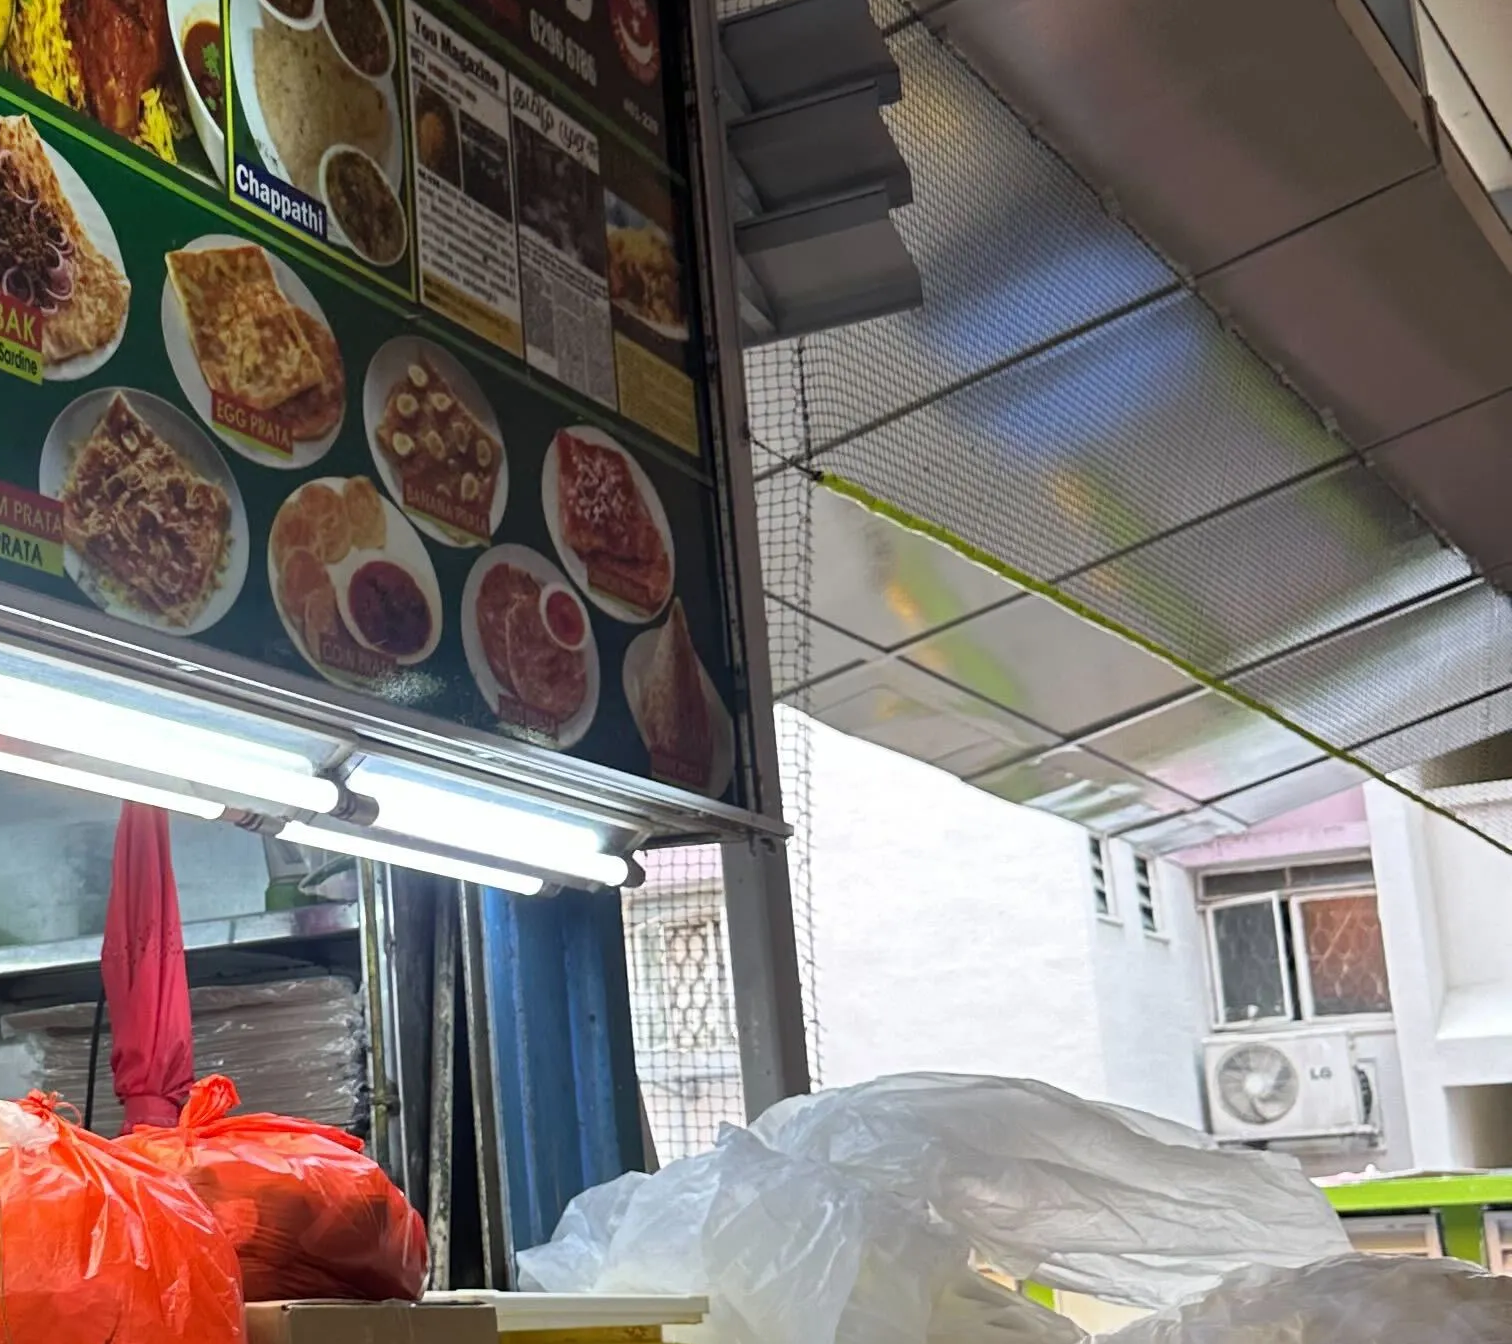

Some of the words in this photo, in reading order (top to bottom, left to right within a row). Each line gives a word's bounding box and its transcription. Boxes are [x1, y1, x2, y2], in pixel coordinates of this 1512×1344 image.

[412, 10, 438, 48] You
[440, 33, 500, 91] Magazine
[235, 164, 325, 234] Chappathi
[216, 400, 246, 429] EGG
[13, 498, 64, 535] PRATA
[1309, 1066, 1333, 1082] LG
